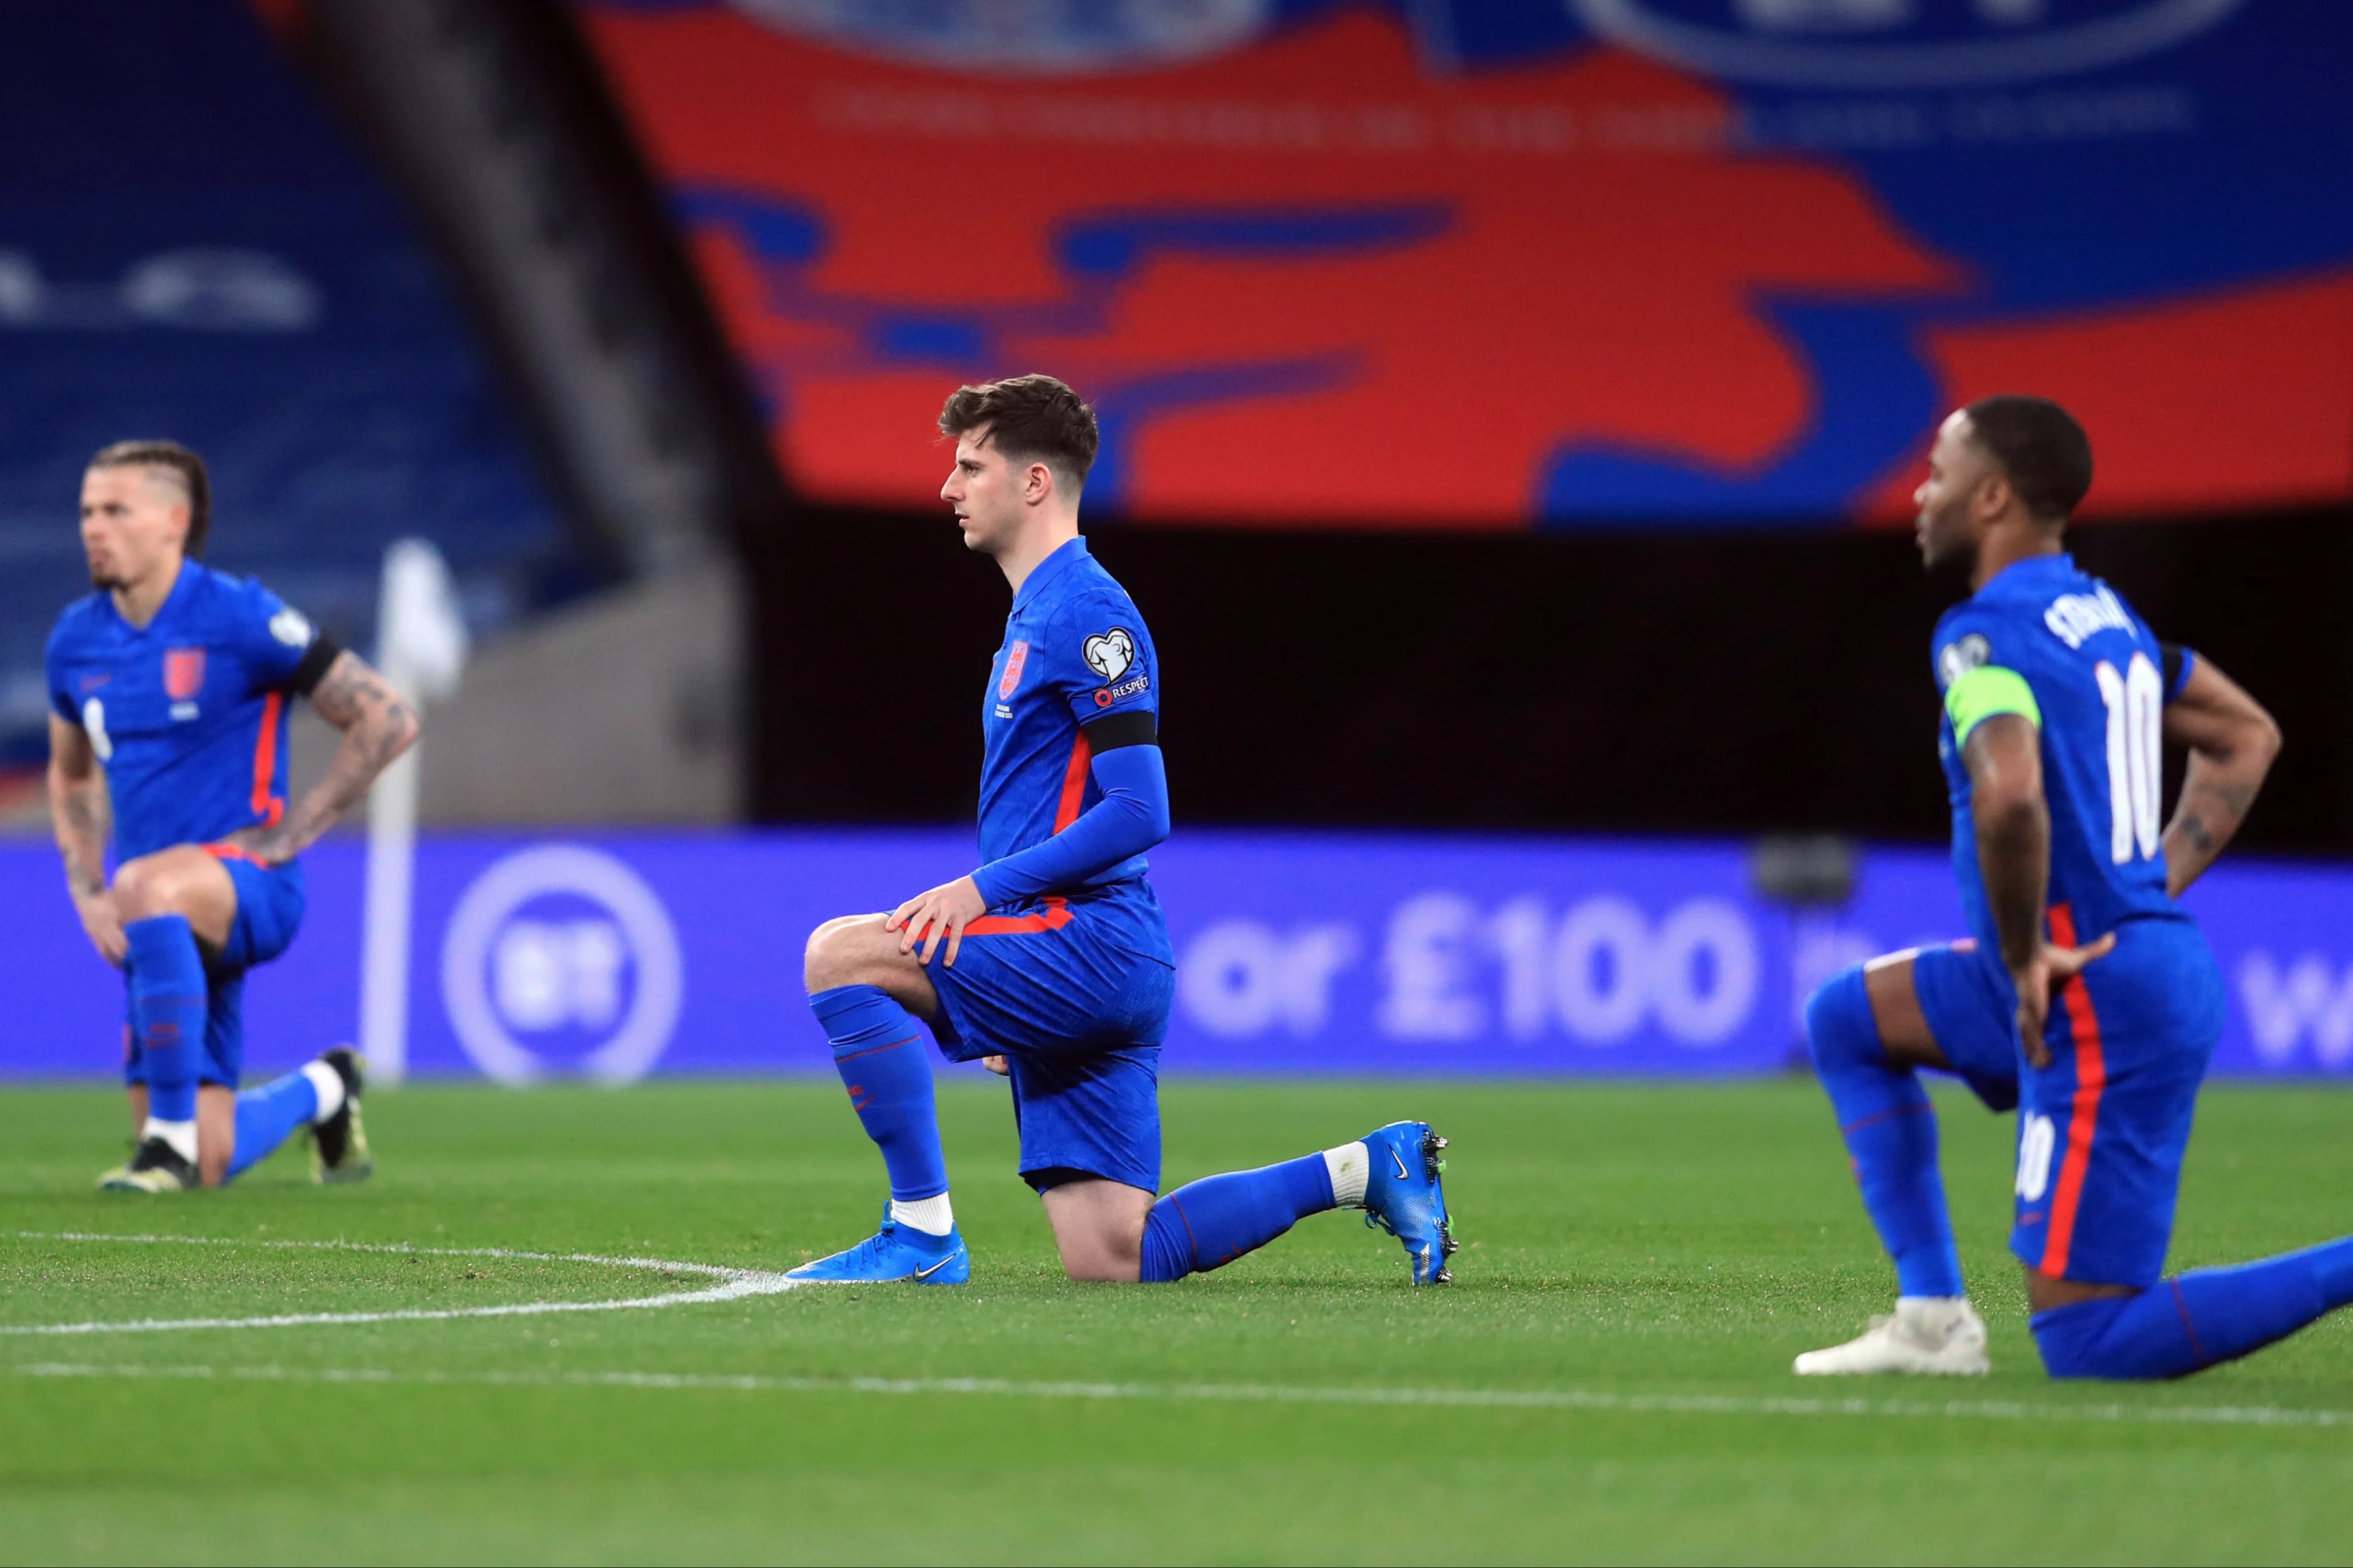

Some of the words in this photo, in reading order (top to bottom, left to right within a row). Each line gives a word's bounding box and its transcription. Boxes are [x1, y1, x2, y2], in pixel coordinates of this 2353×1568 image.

[1112, 676, 1149, 699] RESPECT
[2094, 651, 2163, 865] 10
[1379, 890, 1760, 1046] £100
[2015, 1109, 2056, 1203] 10
